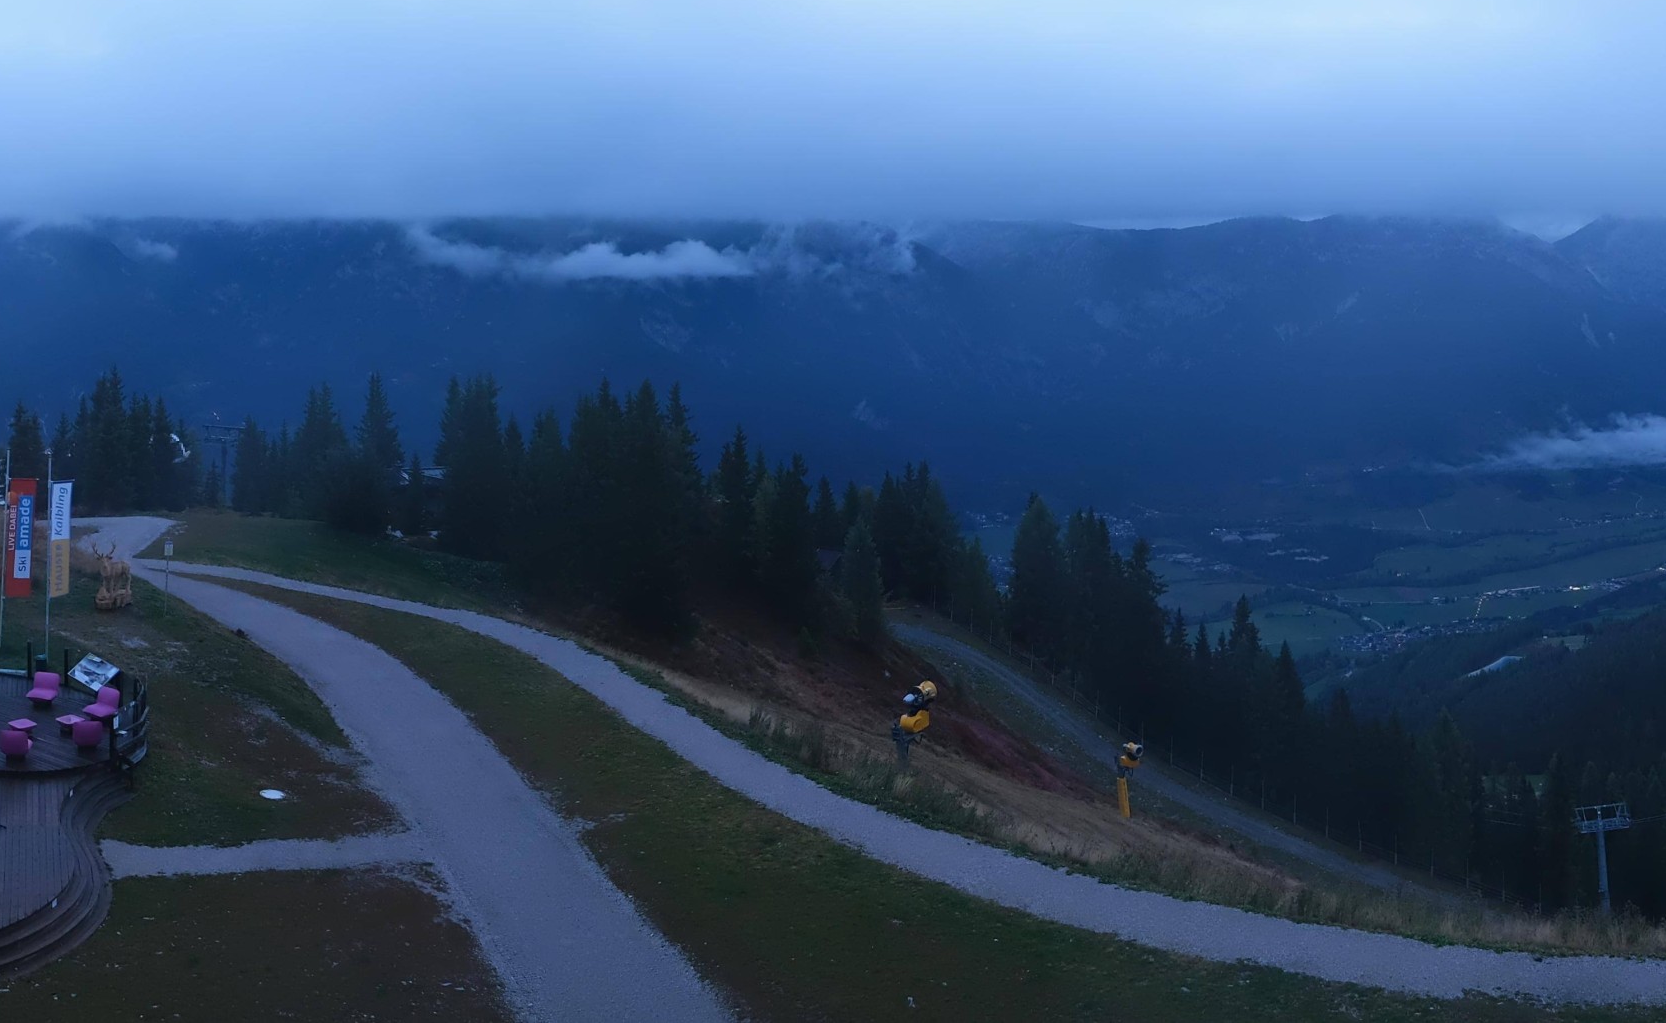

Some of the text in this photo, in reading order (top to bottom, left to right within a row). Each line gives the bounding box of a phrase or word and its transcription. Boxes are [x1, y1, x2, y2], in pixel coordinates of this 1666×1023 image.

[55, 487, 68, 536] Kaibling
[8, 532, 16, 551] LIVE
[18, 556, 27, 572] Ski
